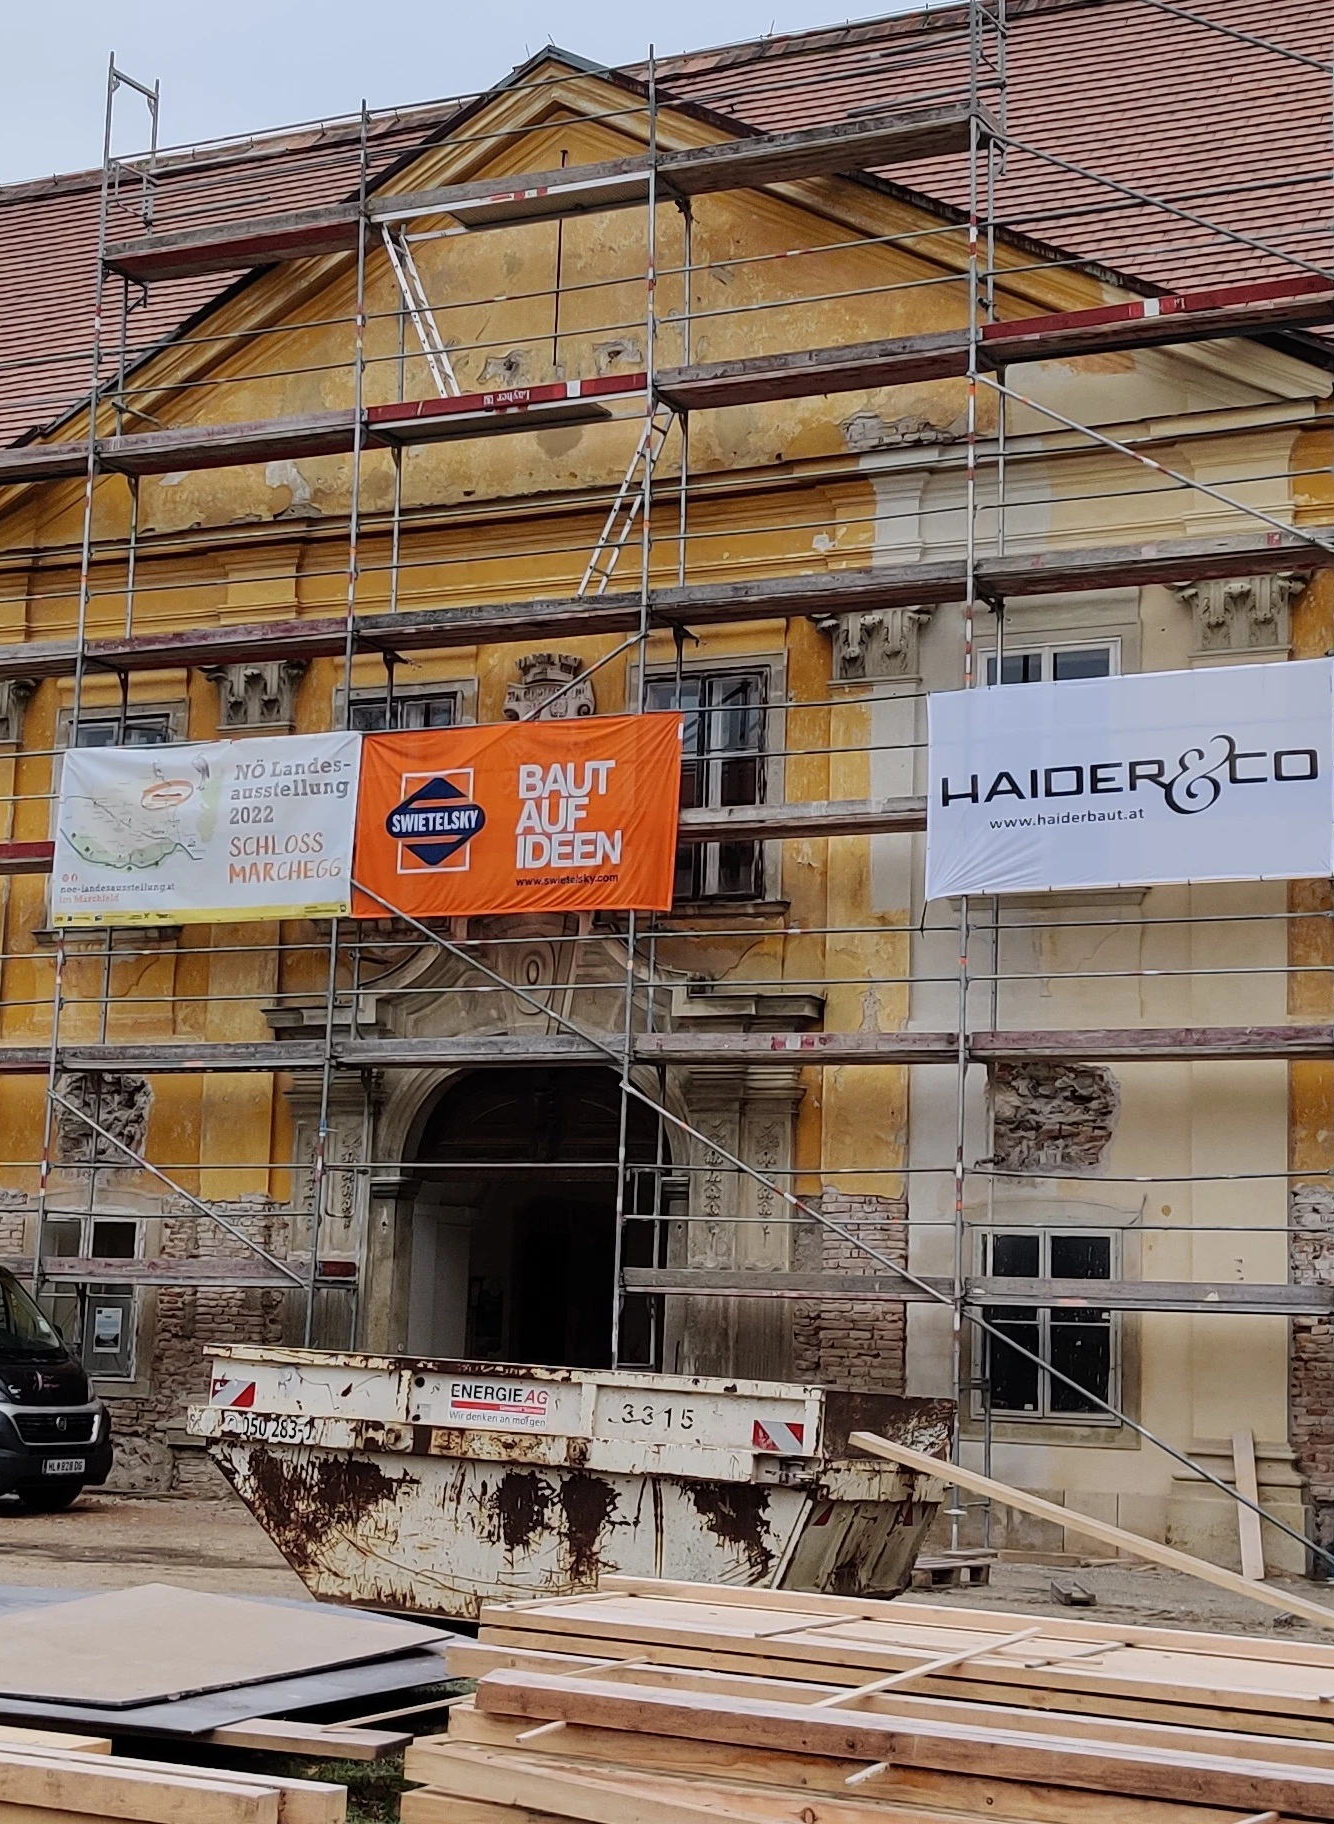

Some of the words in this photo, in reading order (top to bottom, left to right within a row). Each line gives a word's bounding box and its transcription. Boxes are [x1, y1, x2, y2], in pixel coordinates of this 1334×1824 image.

[234, 759, 266, 781] NÖ
[269, 757, 352, 778] Landes-
[518, 759, 616, 799] BAUT
[230, 779, 350, 801] ausstellung
[229, 805, 274, 825] 2022
[391, 809, 479, 833] SWIETELSKY
[515, 796, 590, 835] AUF
[989, 808, 1145, 830] www.haiderbaut.at
[229, 832, 324, 858] SCHLOSS
[515, 829, 623, 870] IDEEN
[229, 857, 343, 884] MARCHEGG
[515, 873, 619, 887] www.swietelsky.com
[60, 883, 175, 894] noe-landesausstellung.at
[449, 1411, 465, 1420] Wir
[466, 1411, 498, 1422] denken
[499, 1416, 511, 1424] an
[512, 1416, 546, 1428] morgen
